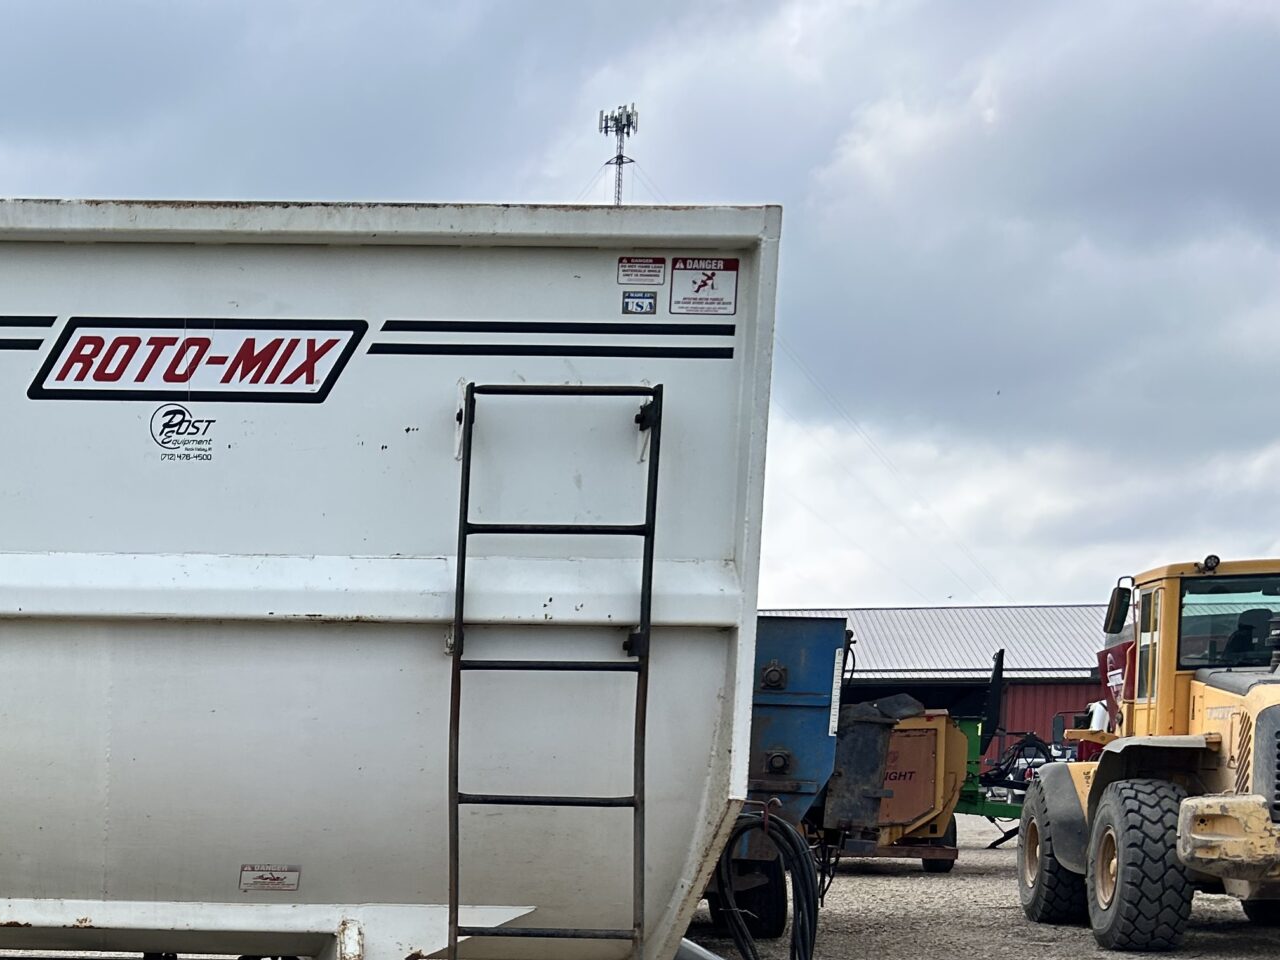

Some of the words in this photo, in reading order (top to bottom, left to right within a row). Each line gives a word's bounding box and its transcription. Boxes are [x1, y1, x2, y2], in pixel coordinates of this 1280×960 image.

[686, 259, 724, 270] DANGER
[624, 301, 654, 312] USA
[55, 335, 341, 385] ROTO-MIX
[159, 409, 216, 436] POST
[161, 430, 212, 446] Equipment
[885, 771, 916, 781] IGHT
